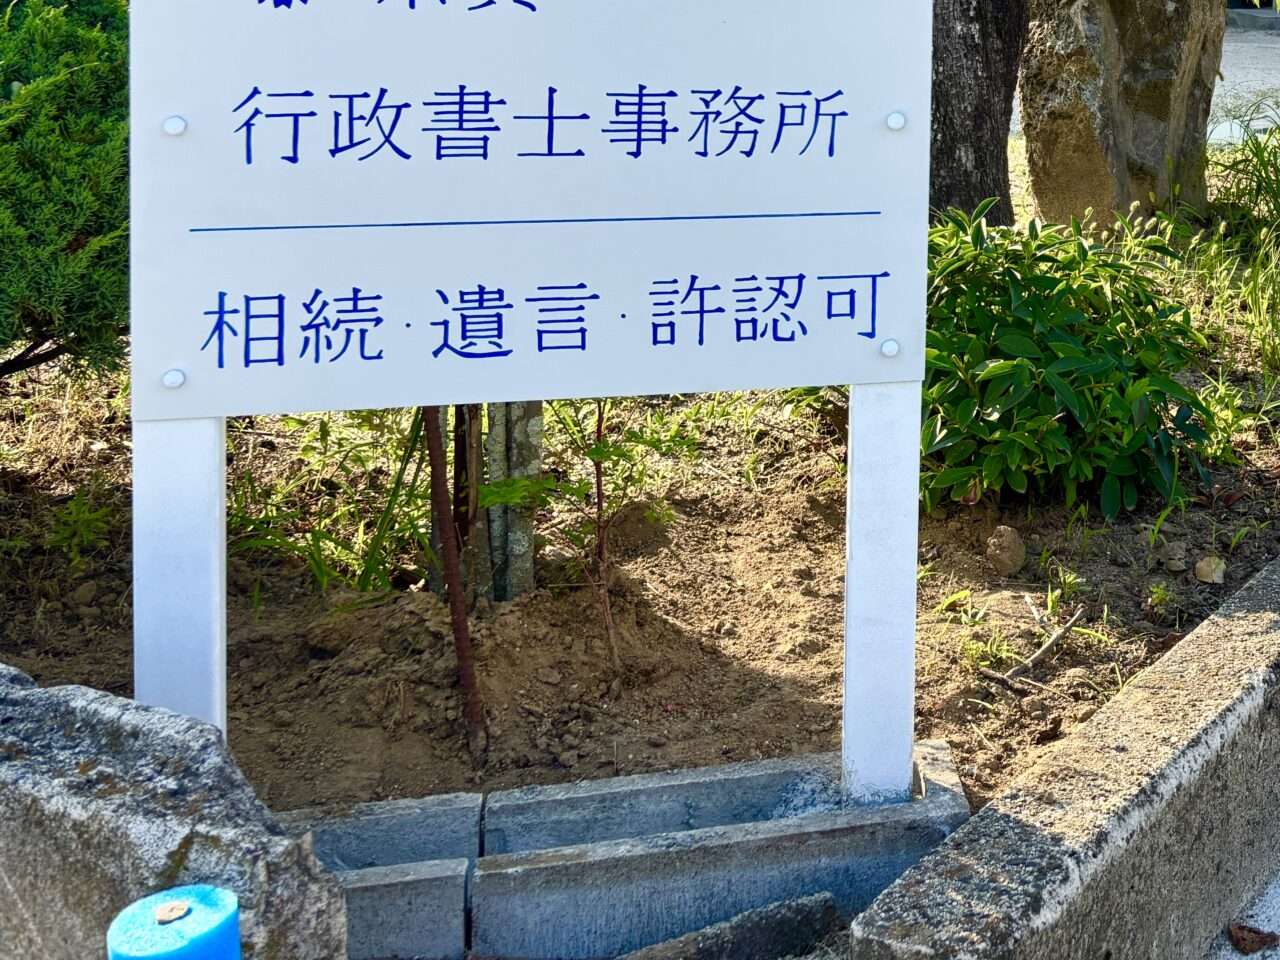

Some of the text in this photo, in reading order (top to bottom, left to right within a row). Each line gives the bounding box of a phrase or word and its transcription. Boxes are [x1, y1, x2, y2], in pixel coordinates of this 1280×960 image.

[233, 82, 850, 165] 行政書士事務所
